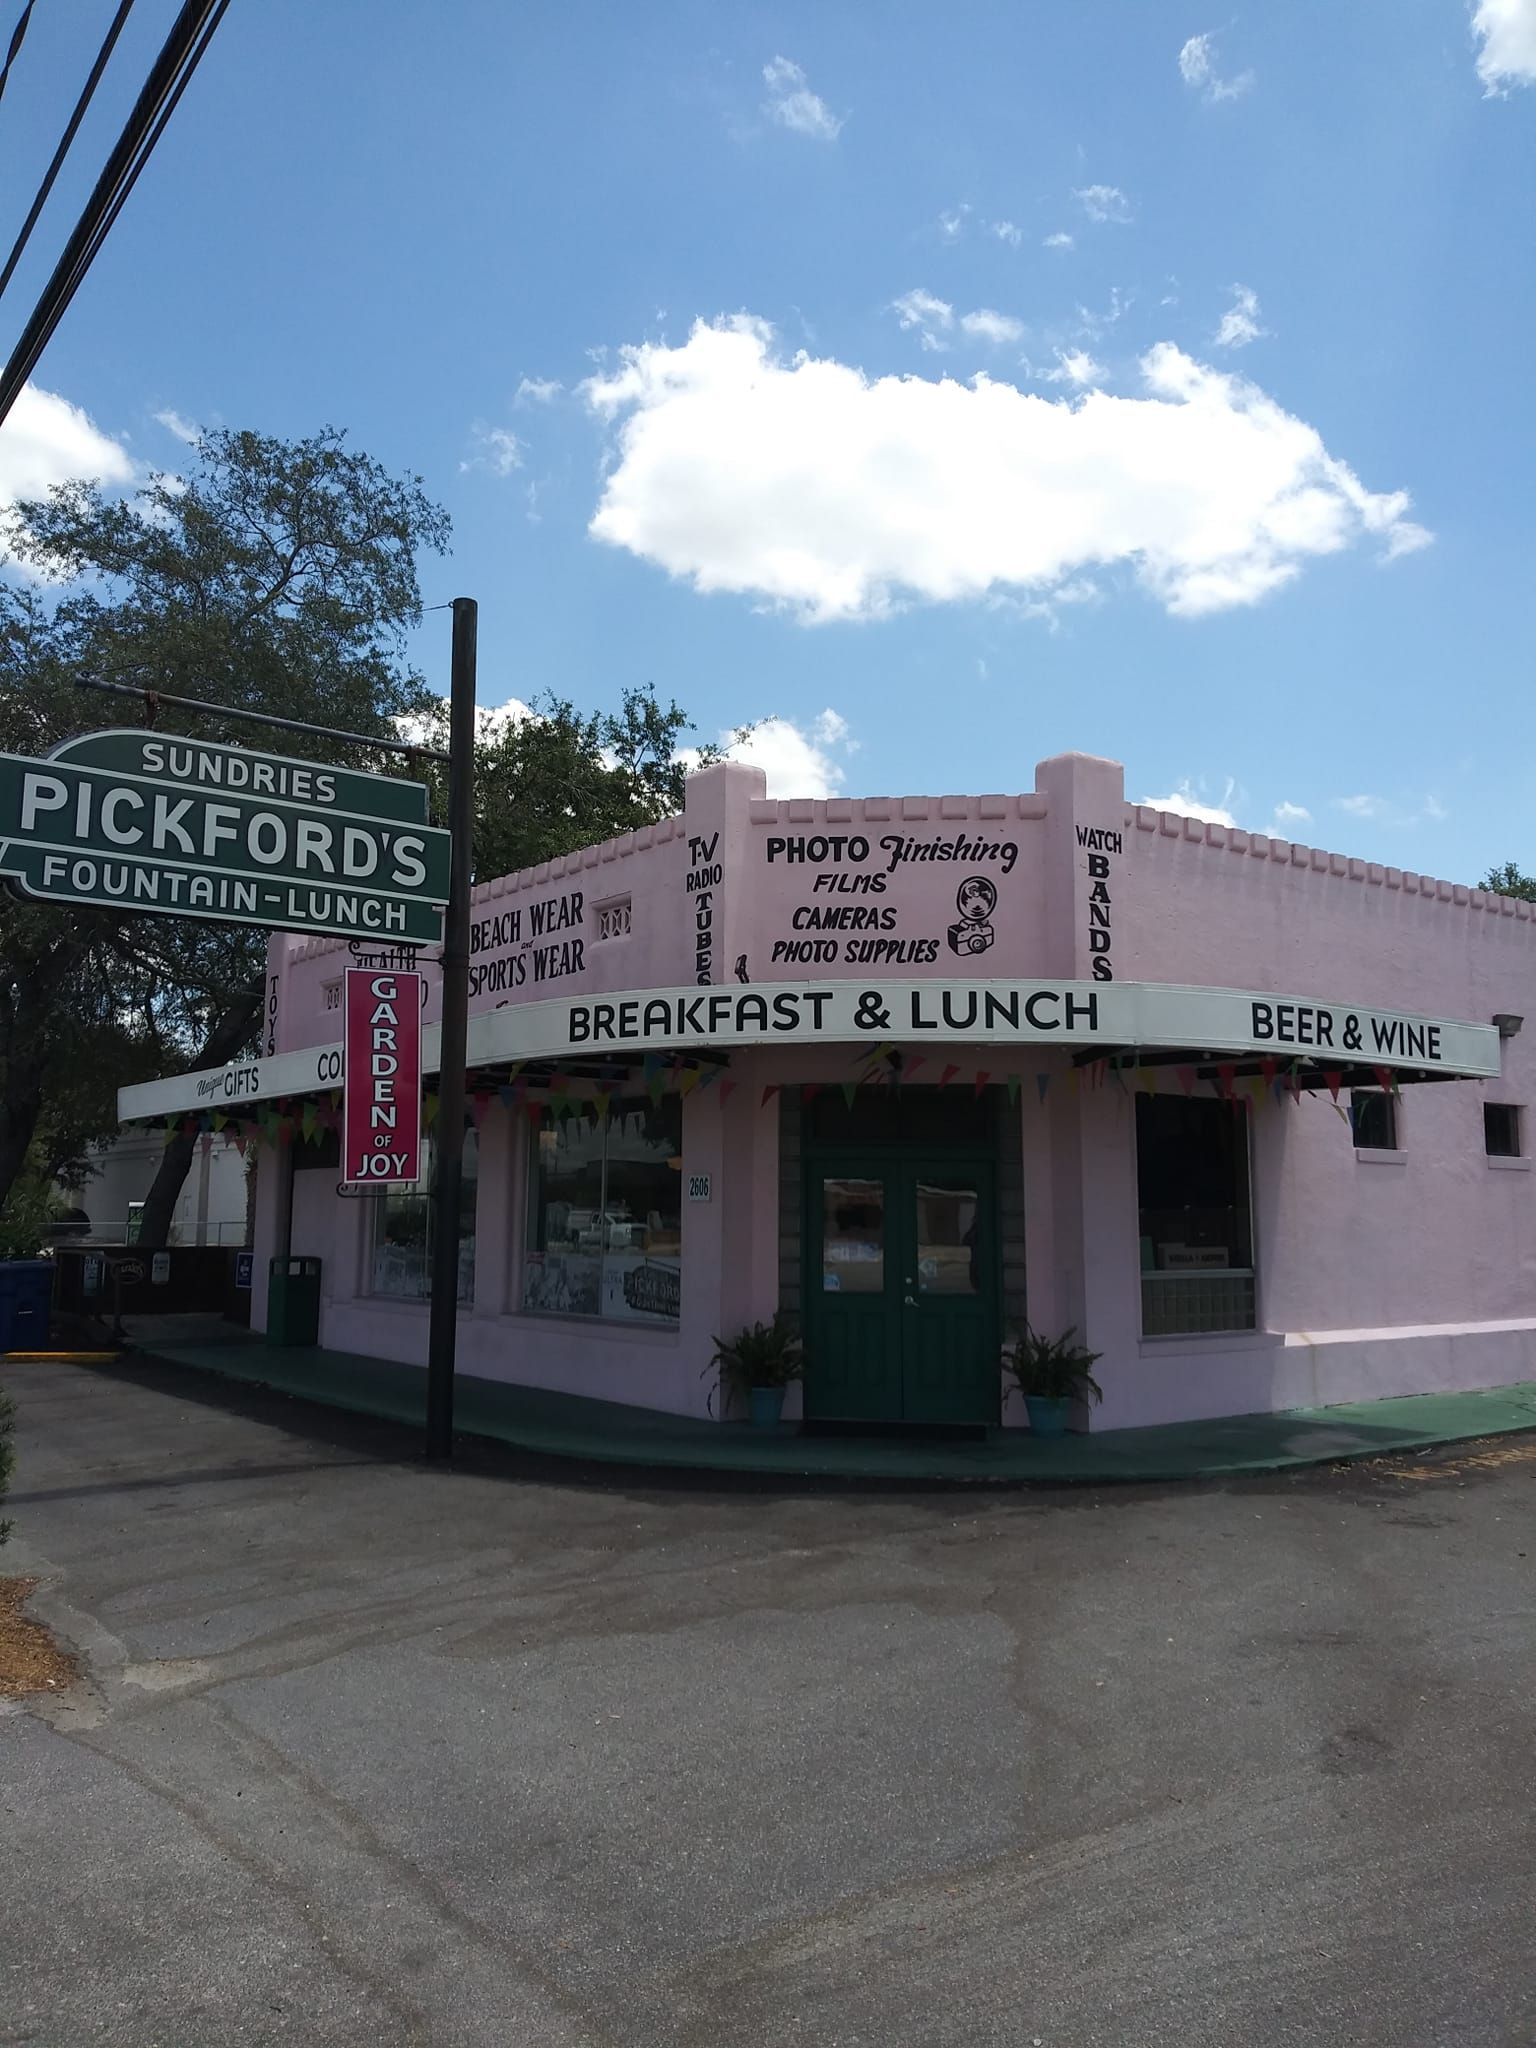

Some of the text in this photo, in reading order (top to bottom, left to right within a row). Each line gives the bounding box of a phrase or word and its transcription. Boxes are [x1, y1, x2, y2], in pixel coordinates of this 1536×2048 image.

[142, 742, 337, 802] SUNDRIES
[20, 773, 427, 887] PICKFORD'S
[767, 833, 1019, 874] PHOTO Finishing
[1075, 825, 1122, 854] WATCH
[686, 863, 722, 893] RADIO
[813, 873, 887, 893] FILMS
[470, 891, 583, 954] BEACH WEAR
[695, 891, 713, 986] TUBES
[792, 906, 897, 930] CAMERAS
[1088, 853, 1113, 981] BANDS
[468, 953, 527, 997] SPORTS
[532, 938, 586, 982] WEAR
[771, 939, 940, 963] PHOTO SUPPLIES
[267, 976, 279, 1057] TOYS
[568, 989, 1098, 1042] BREAKFAST & LUNCH
[1251, 1002, 1441, 1060] BEER & WINE
[369, 976, 399, 1128] GARDEN
[225, 1066, 259, 1096] GIFTS
[374, 1135, 392, 1147] OF
[356, 1153, 408, 1177] JOY
[690, 1177, 709, 1196] 2606
